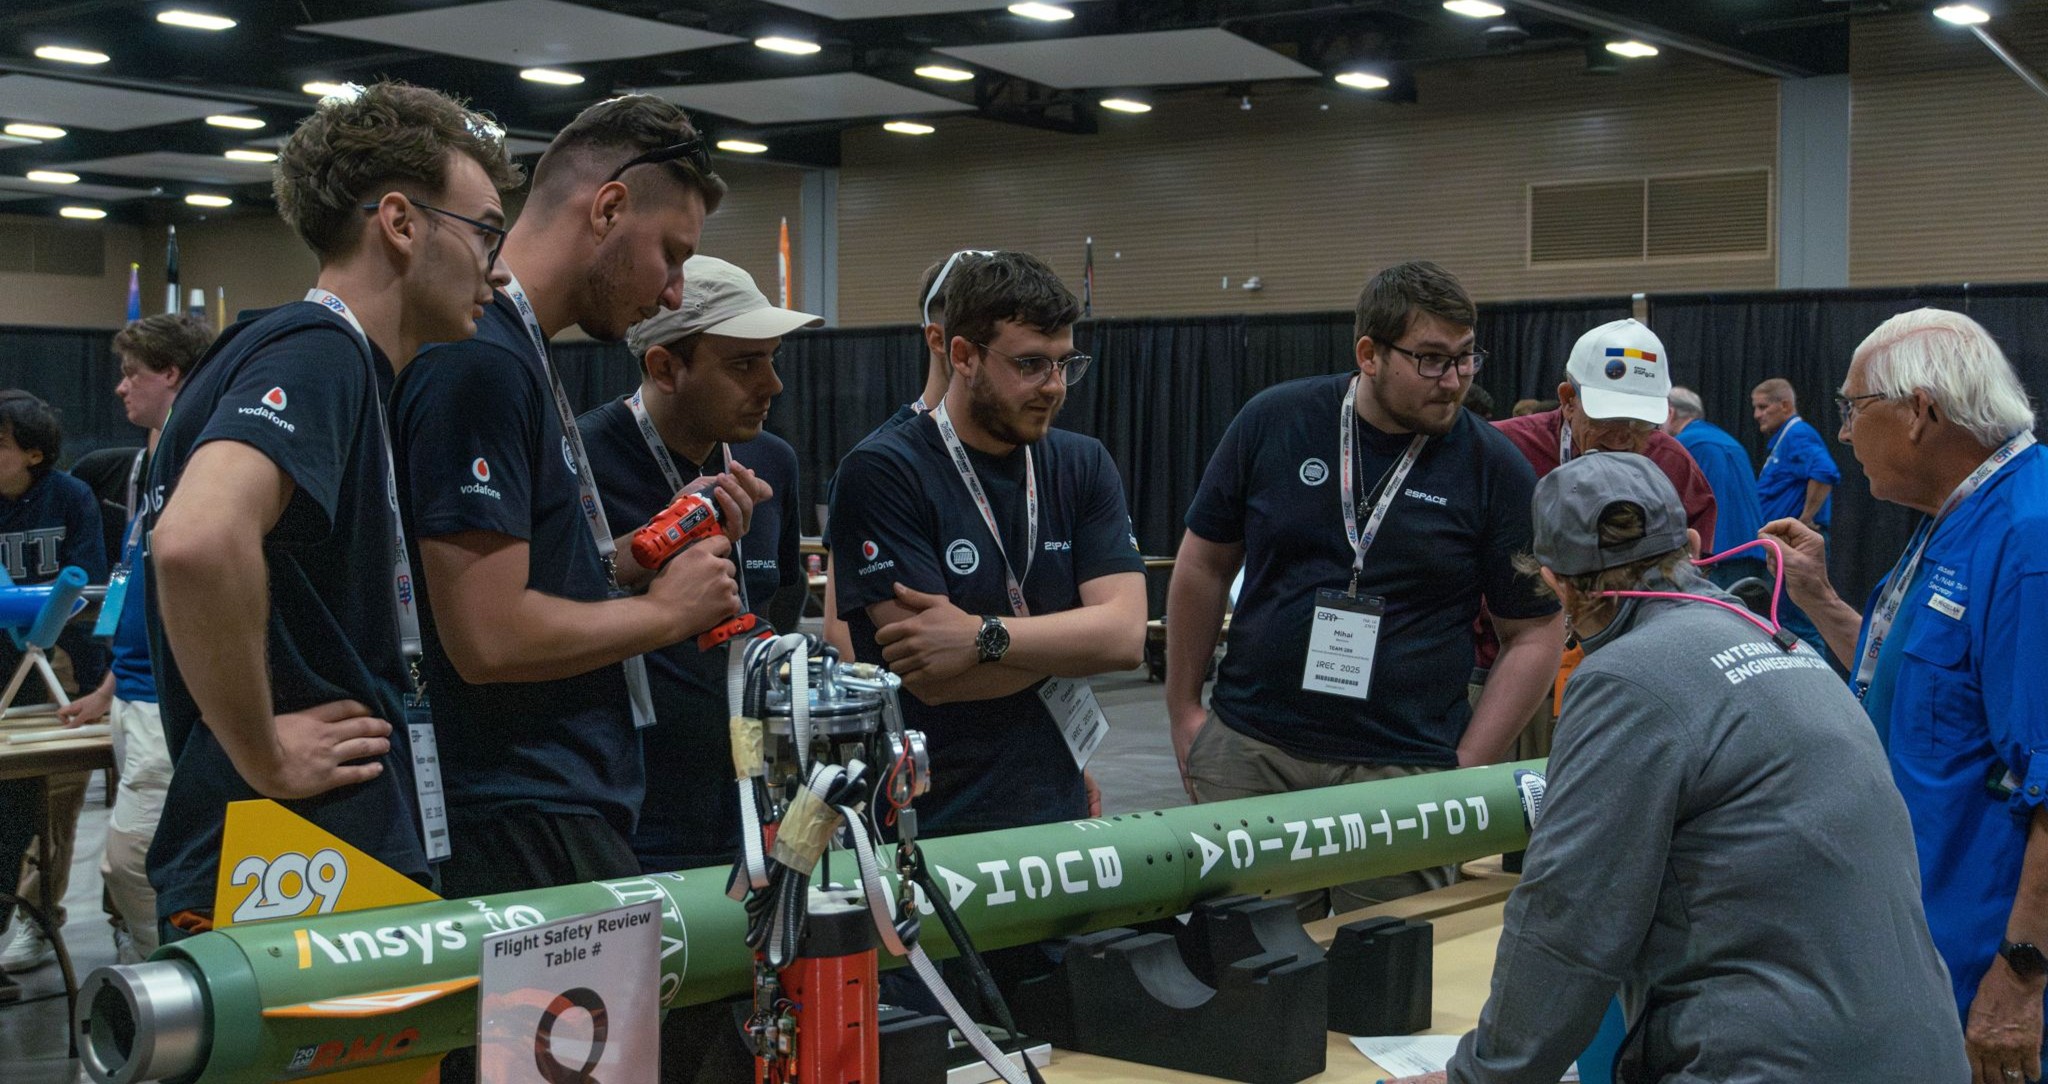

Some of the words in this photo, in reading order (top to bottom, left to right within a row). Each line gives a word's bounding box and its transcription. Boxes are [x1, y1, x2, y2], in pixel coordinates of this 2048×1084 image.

[238, 406, 295, 433] vodafone
[460, 483, 501, 500] vodafone
[1404, 488, 1448, 506] 2SPACE
[0, 526, 67, 579] IT
[746, 560, 777, 569] 2SPACE
[858, 559, 895, 576] vodafone
[1333, 630, 1353, 639] Mihai
[1340, 664, 1360, 674] 2025
[1725, 656, 1812, 685] ENGINEERING
[231, 848, 348, 924] 209
[294, 920, 467, 970] Ansys
[494, 935, 539, 958] Flight
[543, 923, 593, 946] Safety
[598, 912, 651, 934] Review
[545, 945, 586, 968] Table
[591, 942, 602, 955] #
